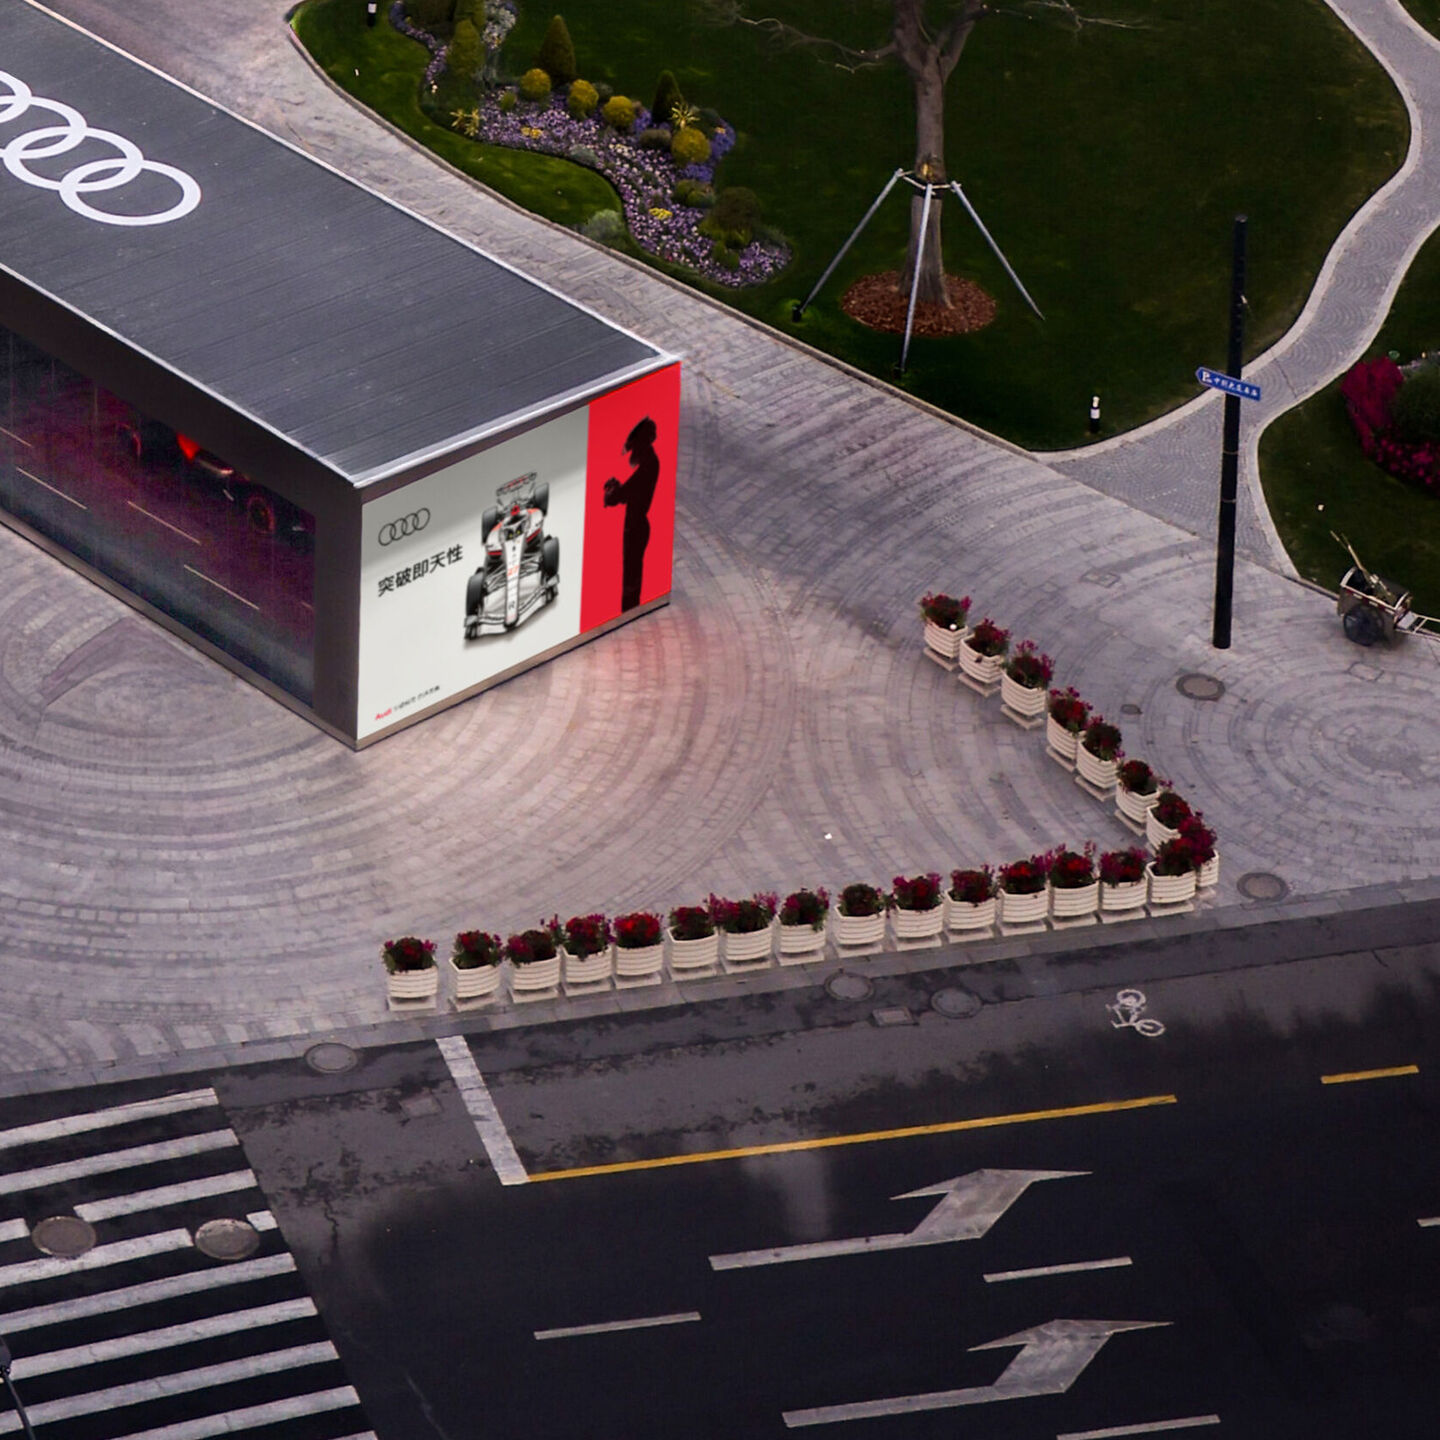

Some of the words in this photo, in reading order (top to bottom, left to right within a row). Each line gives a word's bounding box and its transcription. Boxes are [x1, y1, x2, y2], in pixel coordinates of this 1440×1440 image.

[378, 543, 463, 598] 突破即天性
